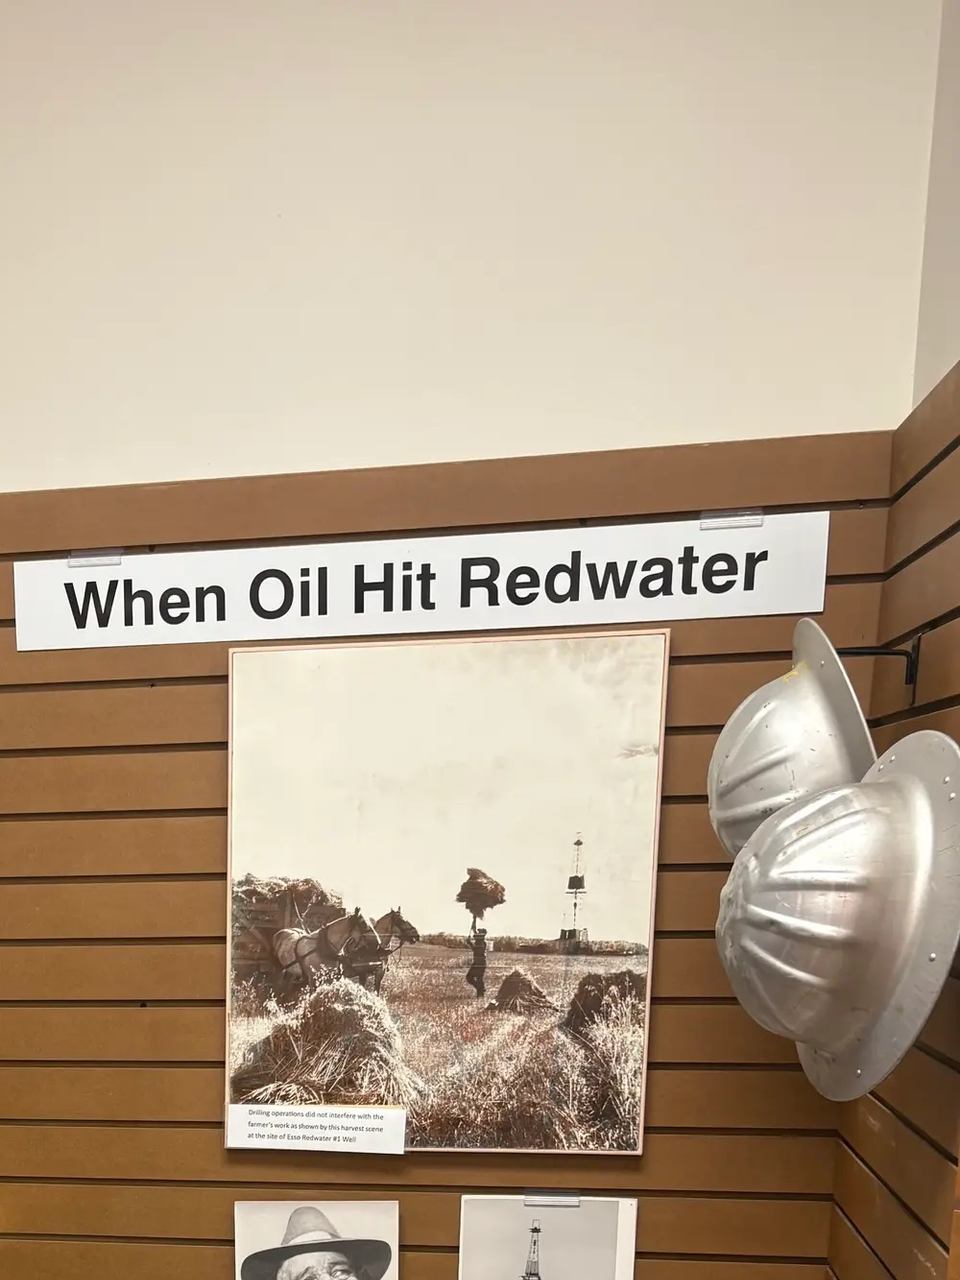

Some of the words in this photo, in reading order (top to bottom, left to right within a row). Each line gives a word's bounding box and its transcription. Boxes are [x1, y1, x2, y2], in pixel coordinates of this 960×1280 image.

[64, 579, 225, 629] When
[250, 567, 327, 619] Oil
[355, 562, 435, 613] Hit
[461, 546, 768, 607] Redwater
[248, 1109, 270, 1117] Drilling
[302, 1135, 332, 1143] Redwater
